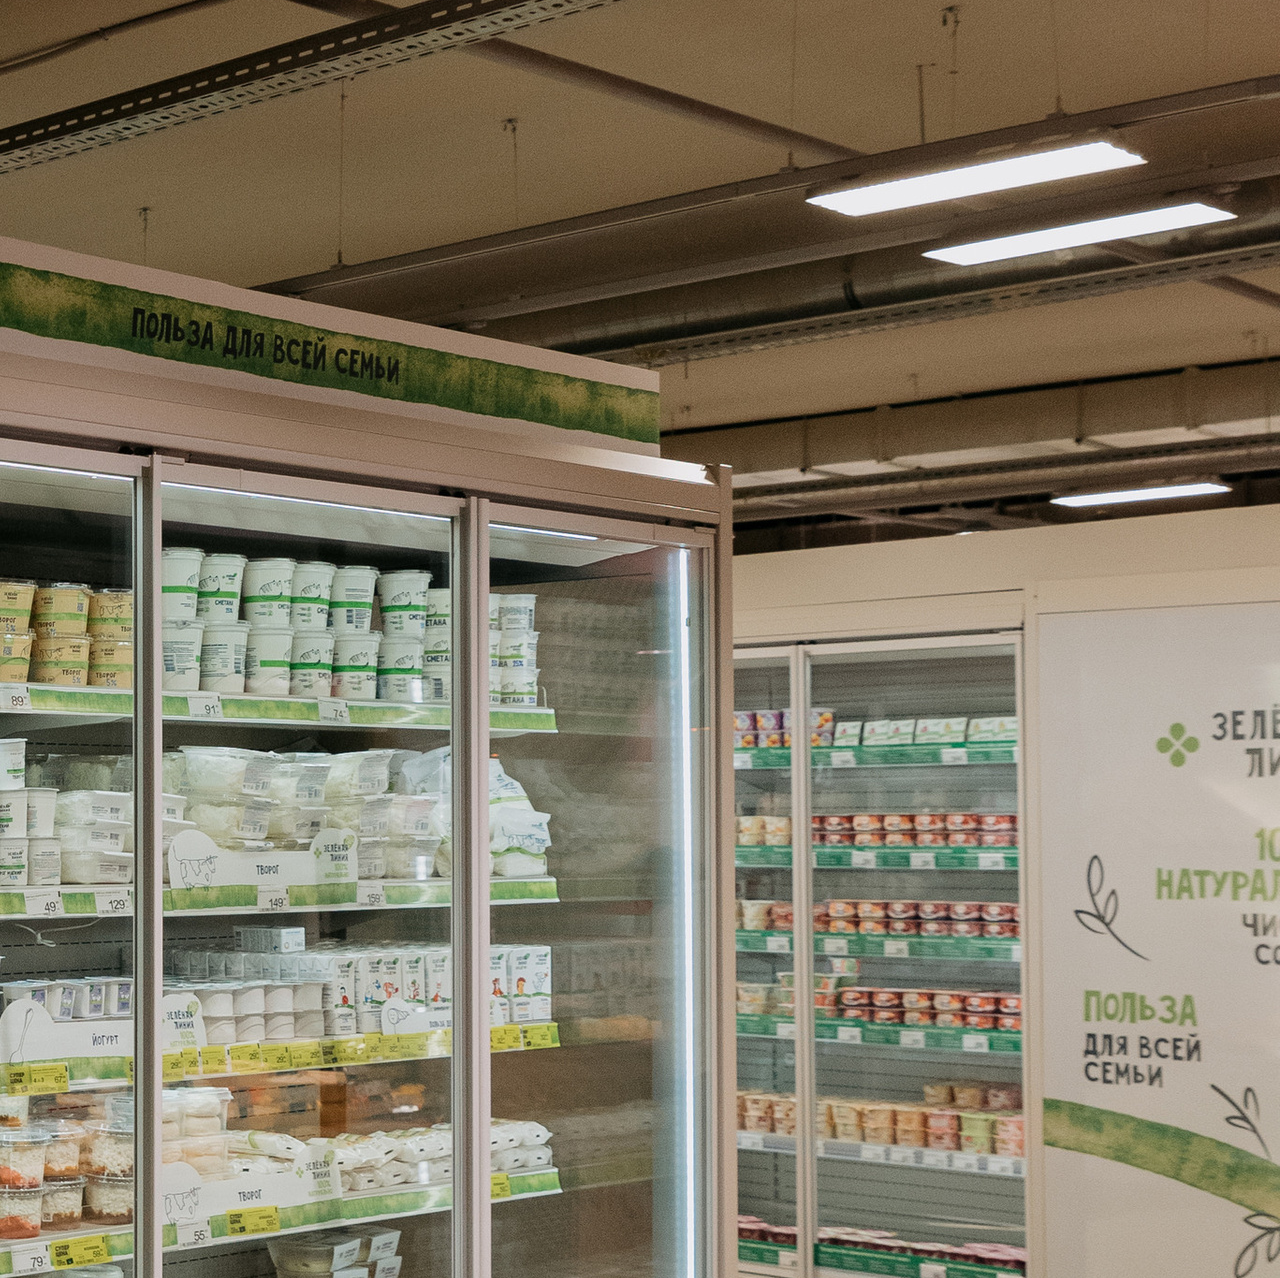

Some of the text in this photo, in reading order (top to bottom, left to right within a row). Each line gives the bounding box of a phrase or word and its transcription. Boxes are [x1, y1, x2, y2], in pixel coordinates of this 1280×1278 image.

[131, 307, 401, 386] ПОЛЬЗА ДЛЯ ВСЕЙ СЕМЬИ
[10, 695, 24, 707] 89
[204, 704, 216, 715] 91
[256, 864, 279, 876] ТВОРОГ
[44, 901, 57, 912] 49
[108, 899, 126, 910] 129
[268, 898, 284, 908] 149
[1083, 990, 1198, 1027] ПОЛЬЗА
[91, 1032, 119, 1047] ЙОГУРТ
[1083, 1032, 1202, 1062] ДЛЯ ВСЕЙ
[1083, 1060, 1164, 1089] СЕМЬИ
[237, 1189, 263, 1202] ТВОРОГ
[193, 1230, 206, 1242] 55
[54, 1244, 70, 1252] СУПЕР
[29, 1255, 44, 1268] 79
